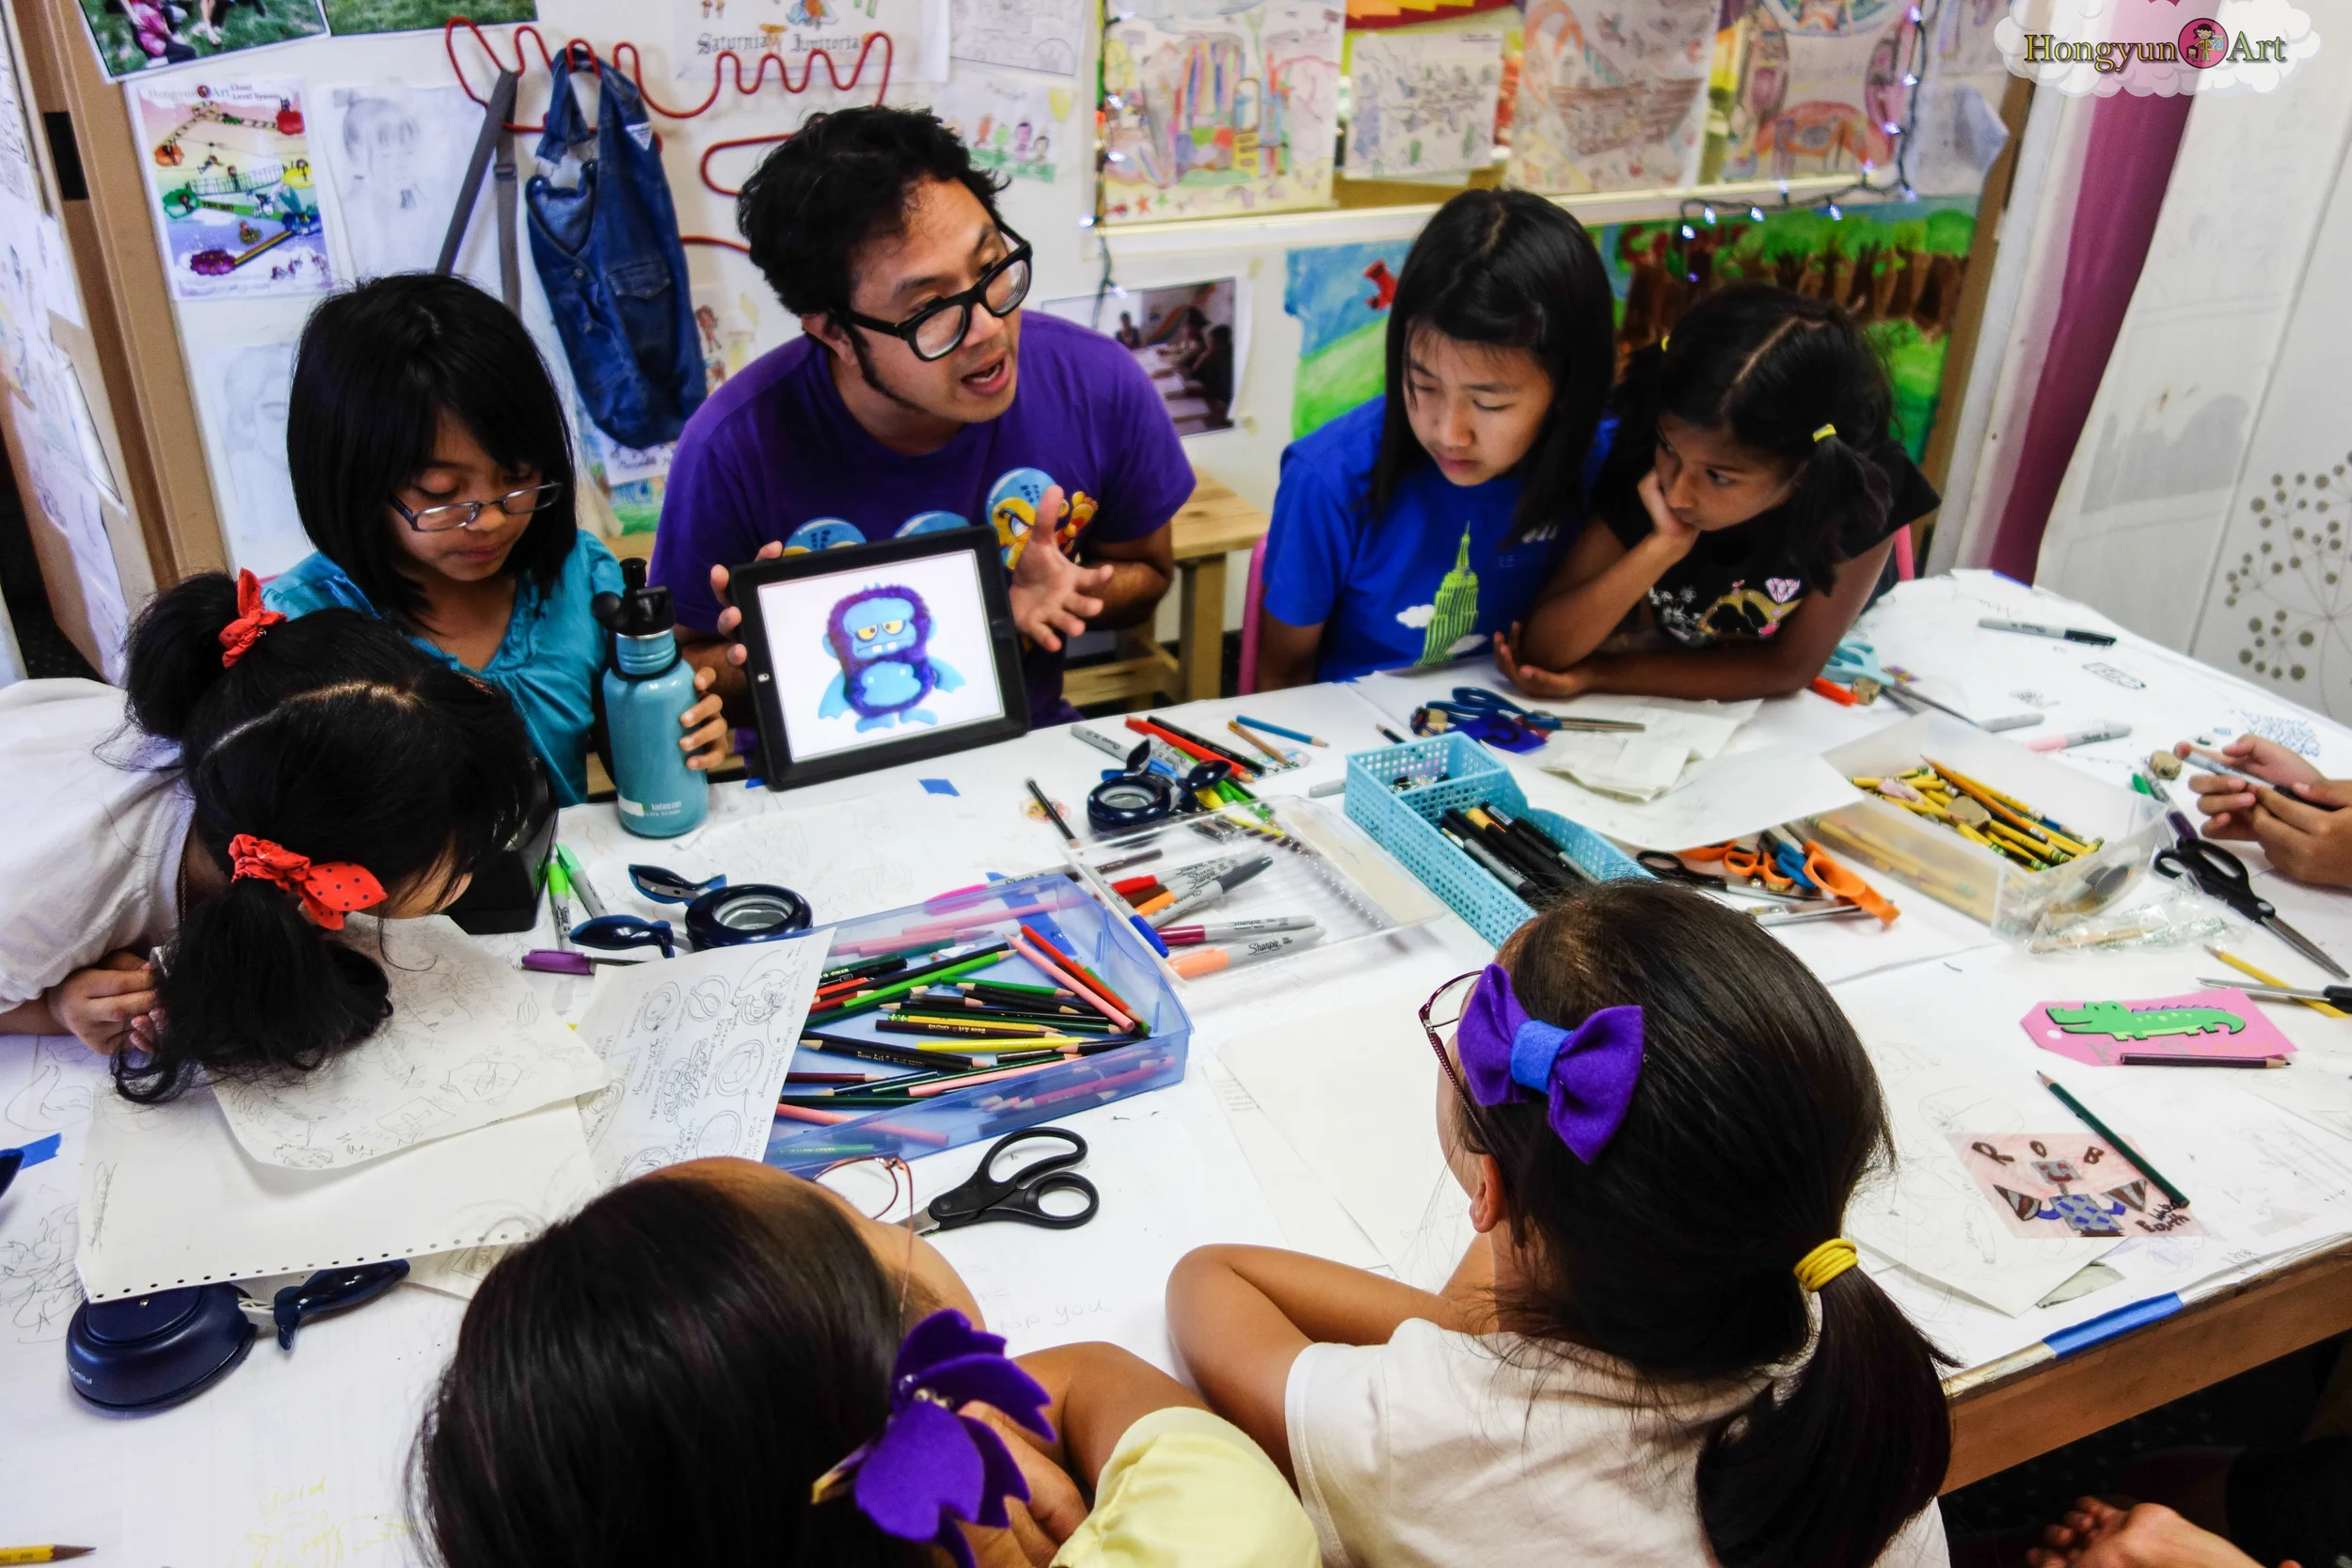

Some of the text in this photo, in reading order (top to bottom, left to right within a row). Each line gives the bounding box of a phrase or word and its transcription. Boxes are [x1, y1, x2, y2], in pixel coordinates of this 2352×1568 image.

[213, 87, 230, 98] Art
[1186, 870, 1221, 891] Sharpie
[1248, 939, 1283, 956] Sharpie
[1052, 1298, 1114, 1326] you
